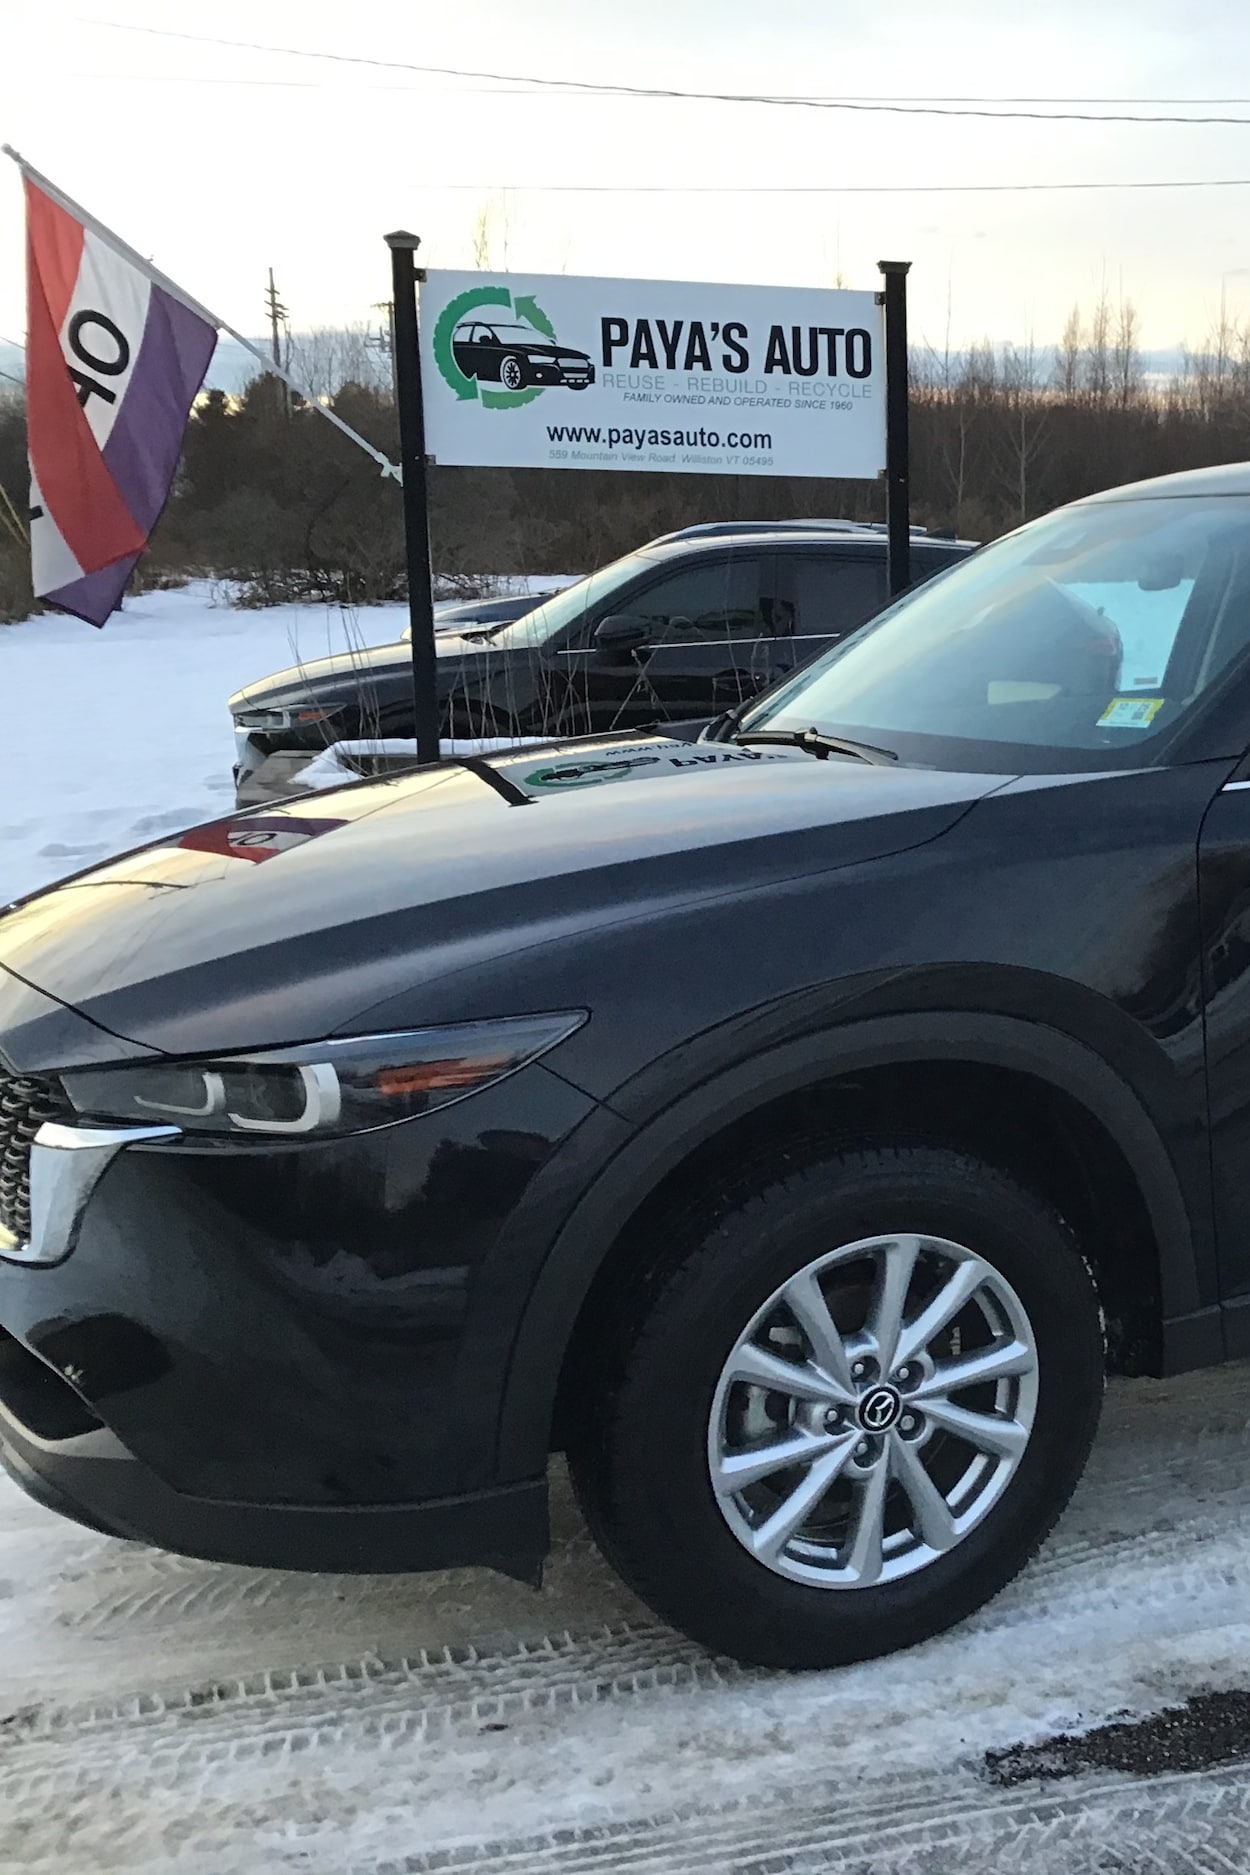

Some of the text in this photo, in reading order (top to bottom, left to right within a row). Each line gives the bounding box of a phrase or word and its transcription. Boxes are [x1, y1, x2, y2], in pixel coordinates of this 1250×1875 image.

[601, 316, 872, 379] PAYA'S AUTO
[602, 373, 666, 391] REUSE
[686, 376, 768, 394] REBUILD
[788, 380, 873, 399] RECYCLE
[623, 392, 853, 411] FAMILY OWNED AND OPERATED SINCE 1960
[546, 425, 772, 450] www.payasauto.com
[548, 449, 774, 467] 559 Mountain View Road Williston VT 05495
